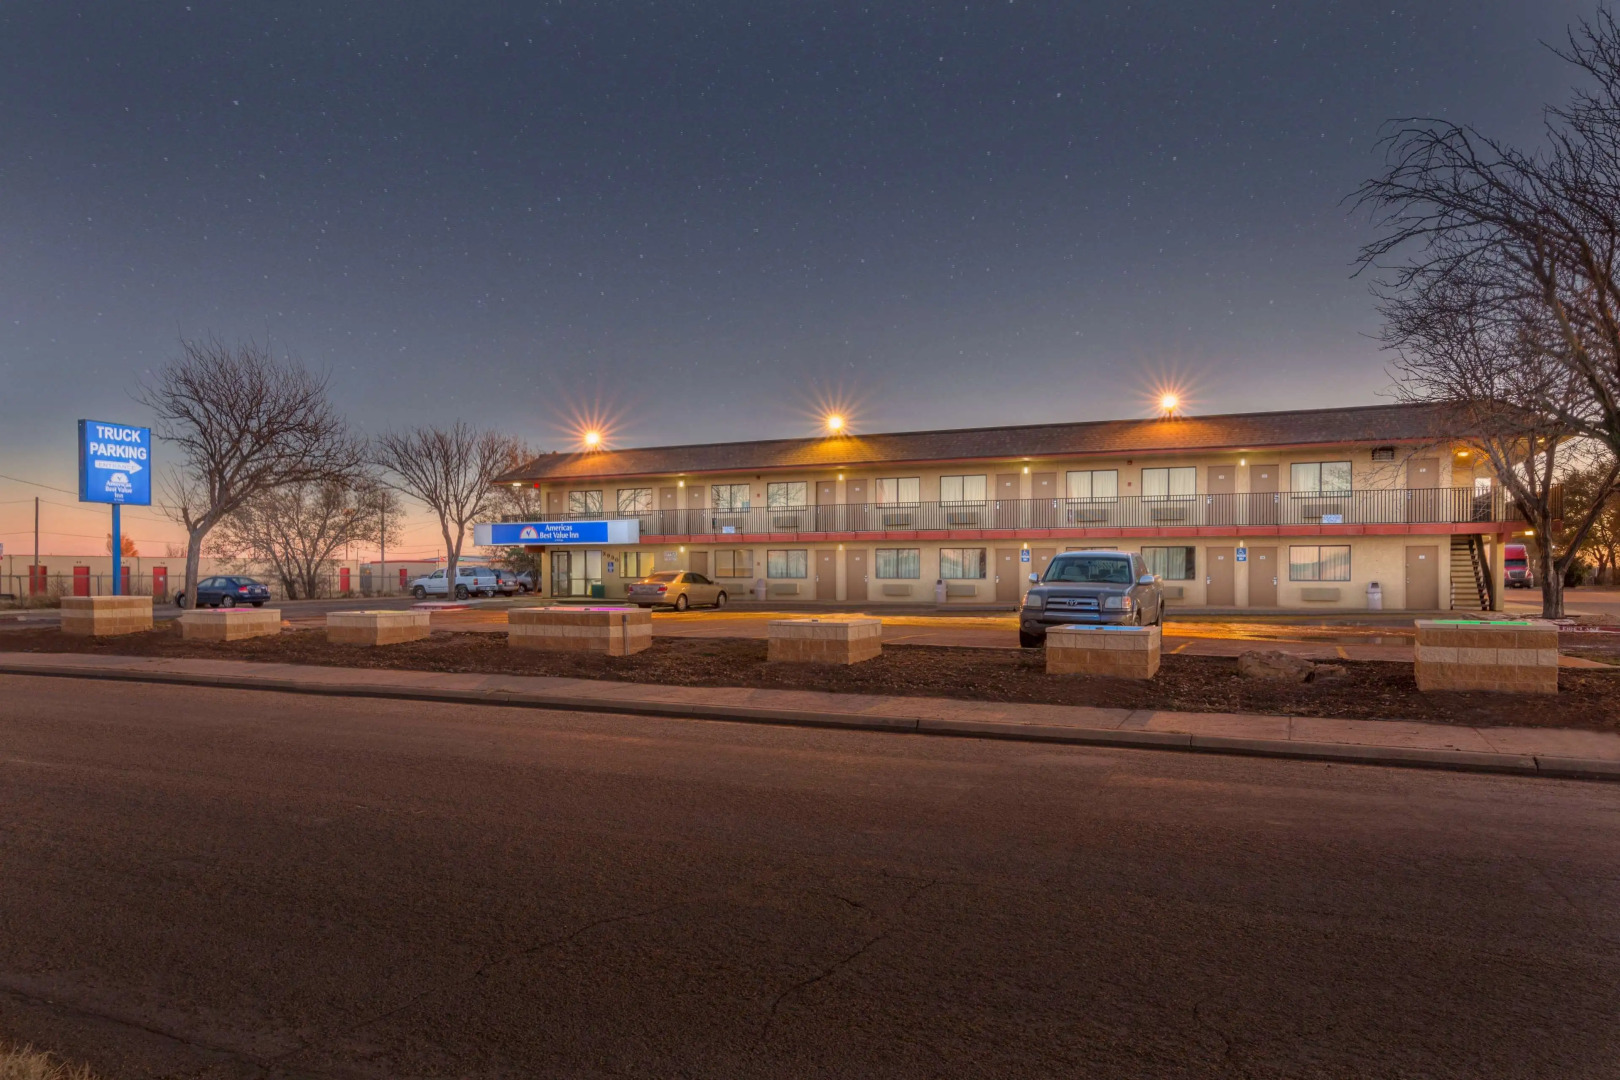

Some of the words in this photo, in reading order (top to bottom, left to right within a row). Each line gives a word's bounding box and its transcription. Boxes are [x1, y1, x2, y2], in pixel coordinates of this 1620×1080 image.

[96, 426, 141, 442] TRUCK
[90, 442, 147, 460] PARKING
[98, 462, 137, 470] ENTRANCE
[117, 486, 132, 494] Value
[553, 531, 568, 539] Value
[569, 531, 579, 539] Inn
